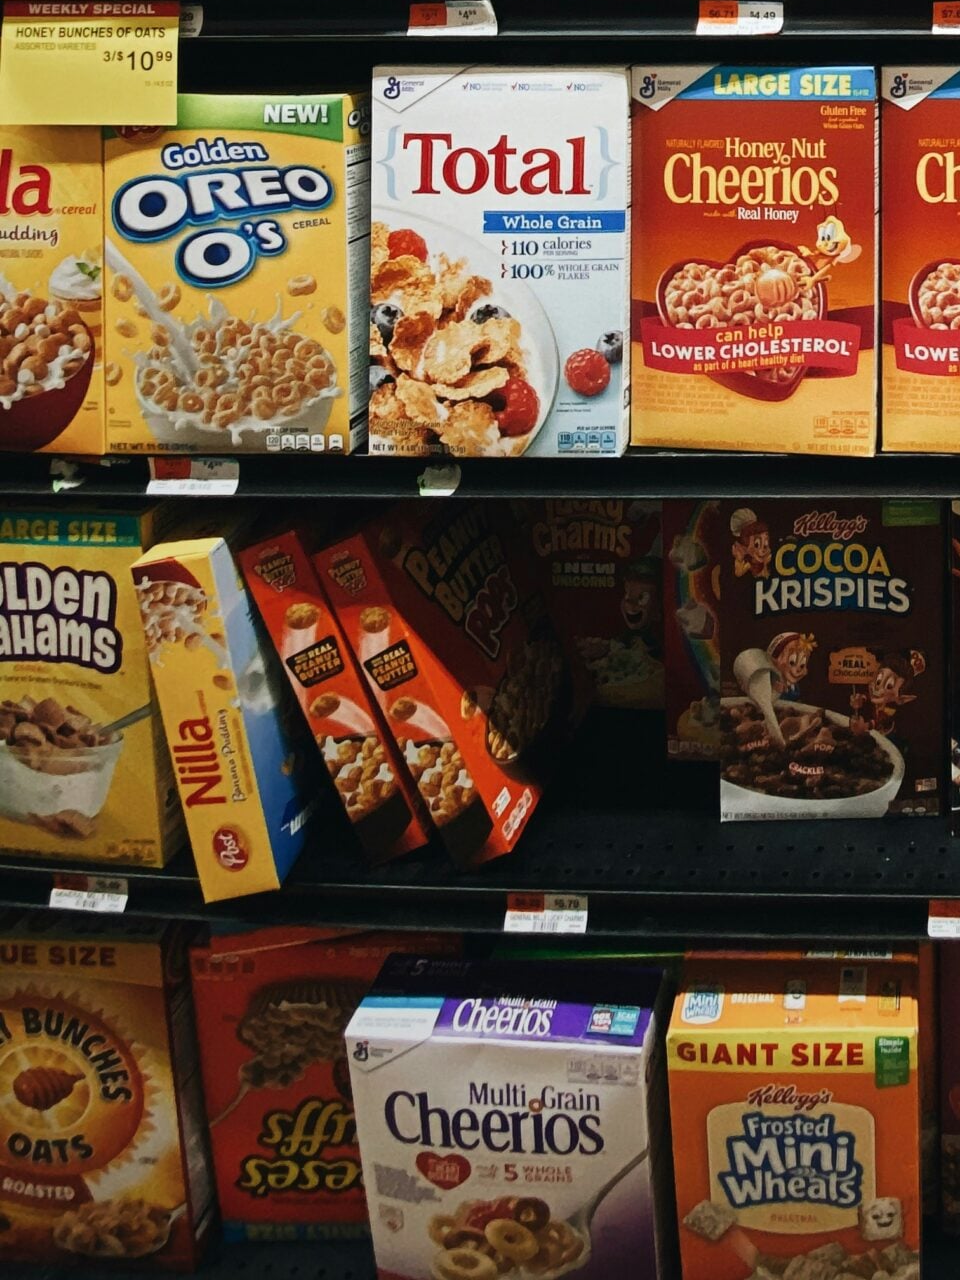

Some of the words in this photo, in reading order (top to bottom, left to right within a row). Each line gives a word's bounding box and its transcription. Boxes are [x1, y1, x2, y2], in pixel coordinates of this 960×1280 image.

[28, 4, 89, 15] WEEKLY
[93, 4, 155, 15] SPECIAL
[16, 27, 55, 38] HONEY
[58, 27, 113, 38] BUNCHES
[116, 27, 131, 38] OF
[134, 27, 165, 38] OATS
[713, 74, 791, 96] LARGE
[800, 74, 852, 96] SIZE
[264, 104, 328, 123] NEW!
[820, 105, 847, 116] Gluten
[849, 105, 867, 116] Free
[163, 141, 266, 167] Golden
[725, 137, 784, 164] Honey
[791, 137, 826, 158] Nut
[403, 133, 591, 195] Total
[663, 152, 841, 207] Cheerios
[118, 167, 330, 232] OREO
[293, 218, 331, 230] CEREAL
[503, 216, 553, 229] Whole
[558, 216, 602, 229] Grain
[511, 241, 539, 256] 110
[543, 237, 592, 250] calories
[511, 263, 555, 279] 100%
[558, 264, 589, 272] WHOLE
[592, 263, 619, 271] GRAIN
[716, 329, 744, 343] can
[748, 325, 784, 340] help
[775, 544, 890, 576] COCOA
[756, 578, 909, 614] KRISPIES
[173, 718, 226, 808] Nilla
[677, 1042, 778, 1066] GIANT
[791, 1042, 864, 1066] SIZE
[469, 1082, 526, 1107] Multi
[541, 1085, 600, 1112] Grain
[747, 1117, 829, 1137] Frosted
[732, 1136, 849, 1176] Mini
[725, 1167, 857, 1204] Wheats
